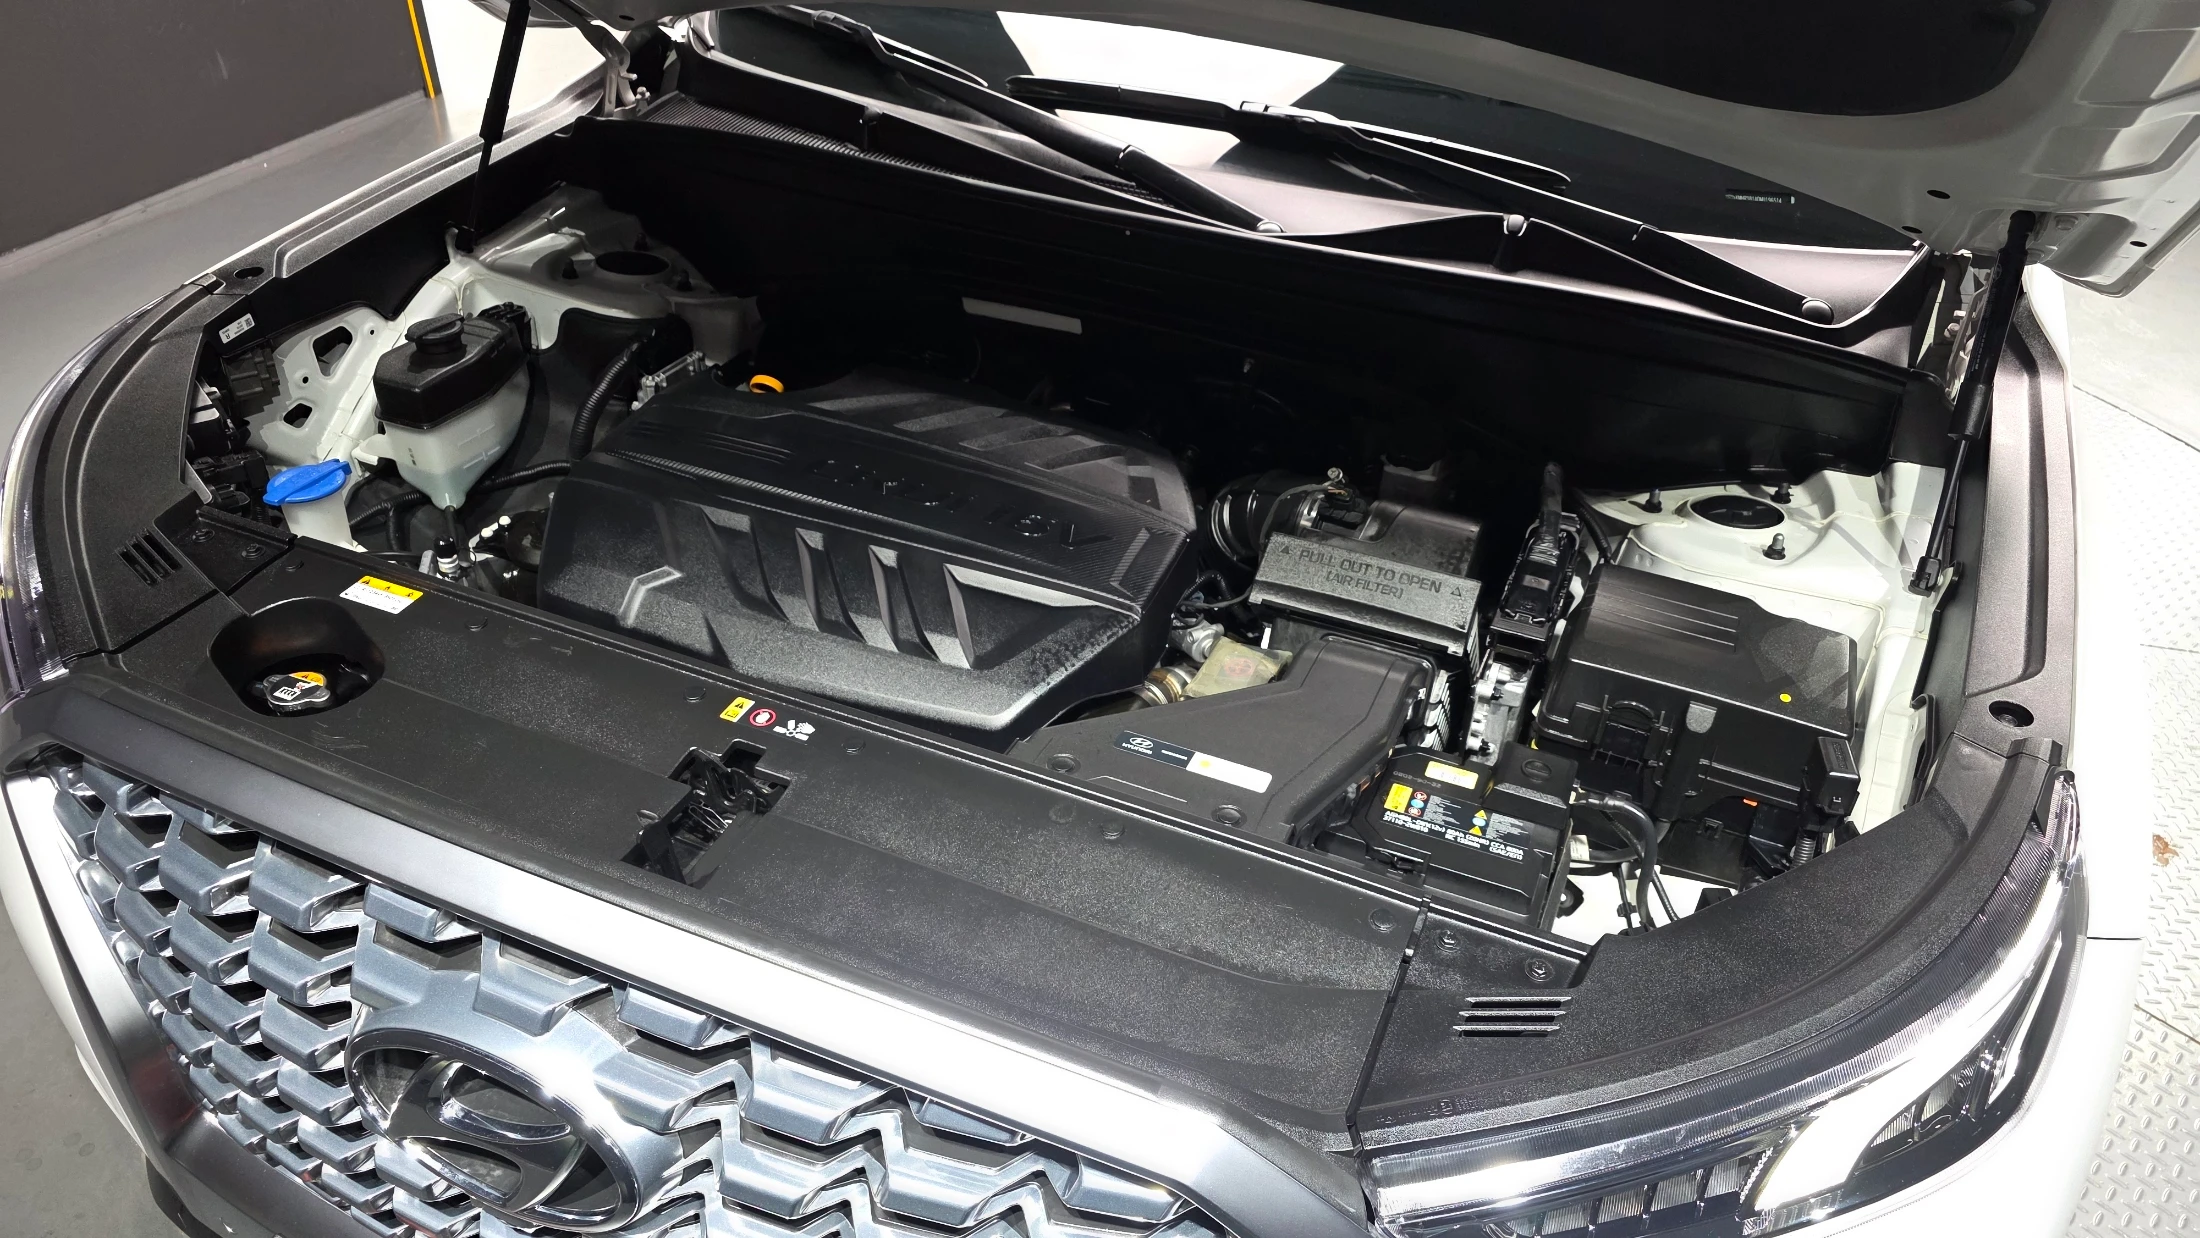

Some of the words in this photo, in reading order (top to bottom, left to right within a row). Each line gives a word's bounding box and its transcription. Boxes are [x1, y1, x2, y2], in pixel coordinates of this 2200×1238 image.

[1299, 550, 1335, 567] PULL
[1340, 557, 1372, 576] OUT
[1375, 565, 1396, 582] TO
[1399, 572, 1442, 593] OPEN
